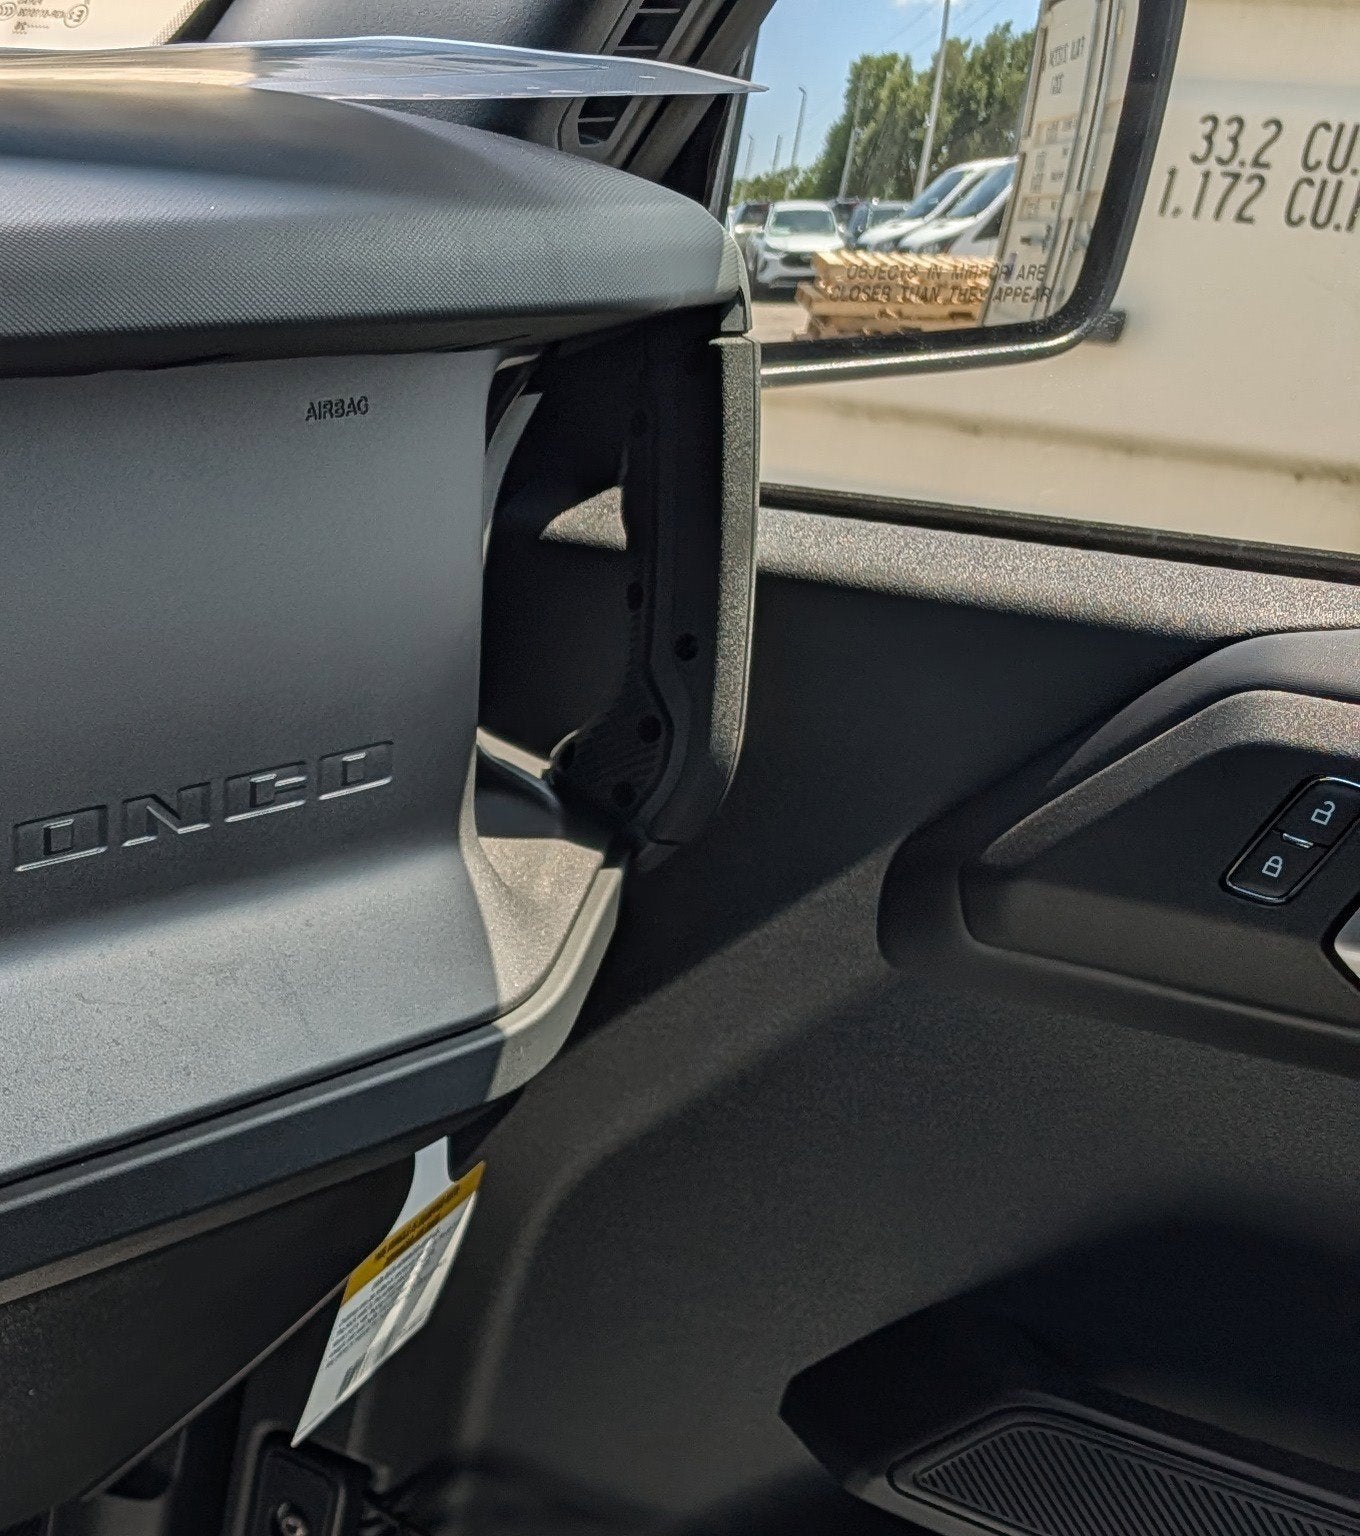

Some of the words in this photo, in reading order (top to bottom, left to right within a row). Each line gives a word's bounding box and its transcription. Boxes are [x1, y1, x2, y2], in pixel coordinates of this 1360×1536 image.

[1189, 114, 1283, 170] 33.2
[1158, 166, 1266, 223] 1.172
[847, 264, 919, 281] OBJECTS
[929, 265, 943, 281] IN
[951, 264, 1009, 281] MIRROR
[1016, 264, 1047, 282] ARE
[831, 284, 891, 302] CLOSER
[902, 285, 941, 302] THAN
[991, 286, 1052, 303] APPEAR
[305, 396, 369, 422] AIRBAG
